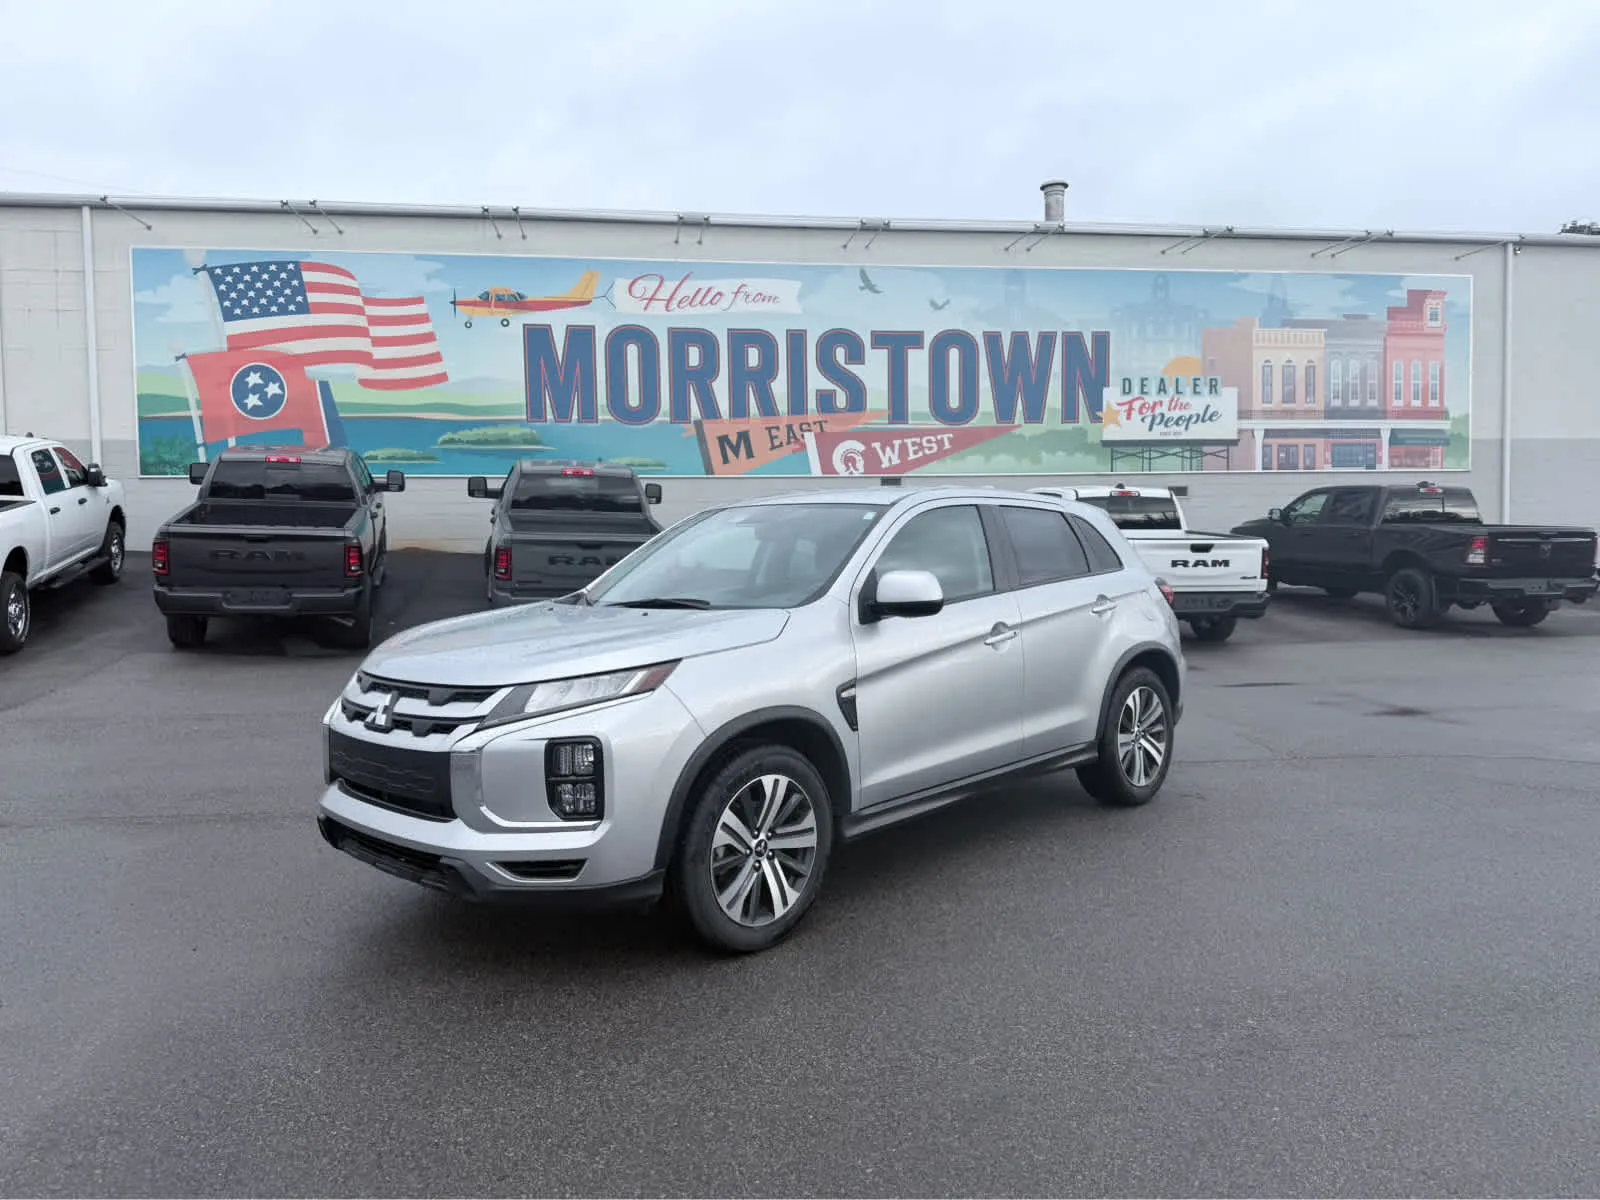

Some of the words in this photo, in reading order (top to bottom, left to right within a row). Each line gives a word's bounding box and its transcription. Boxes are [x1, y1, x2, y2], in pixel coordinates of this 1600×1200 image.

[628, 271, 725, 312] Hello
[722, 283, 780, 312] from
[523, 323, 1110, 426] MORRISTOWN
[1122, 377, 1219, 396] DEALER
[1116, 396, 1164, 421] For
[1167, 395, 1193, 413] the
[1141, 404, 1222, 432] People
[716, 430, 756, 465] M
[765, 420, 829, 451] EAST
[871, 433, 954, 468] WEST
[1170, 559, 1231, 568] RAM
